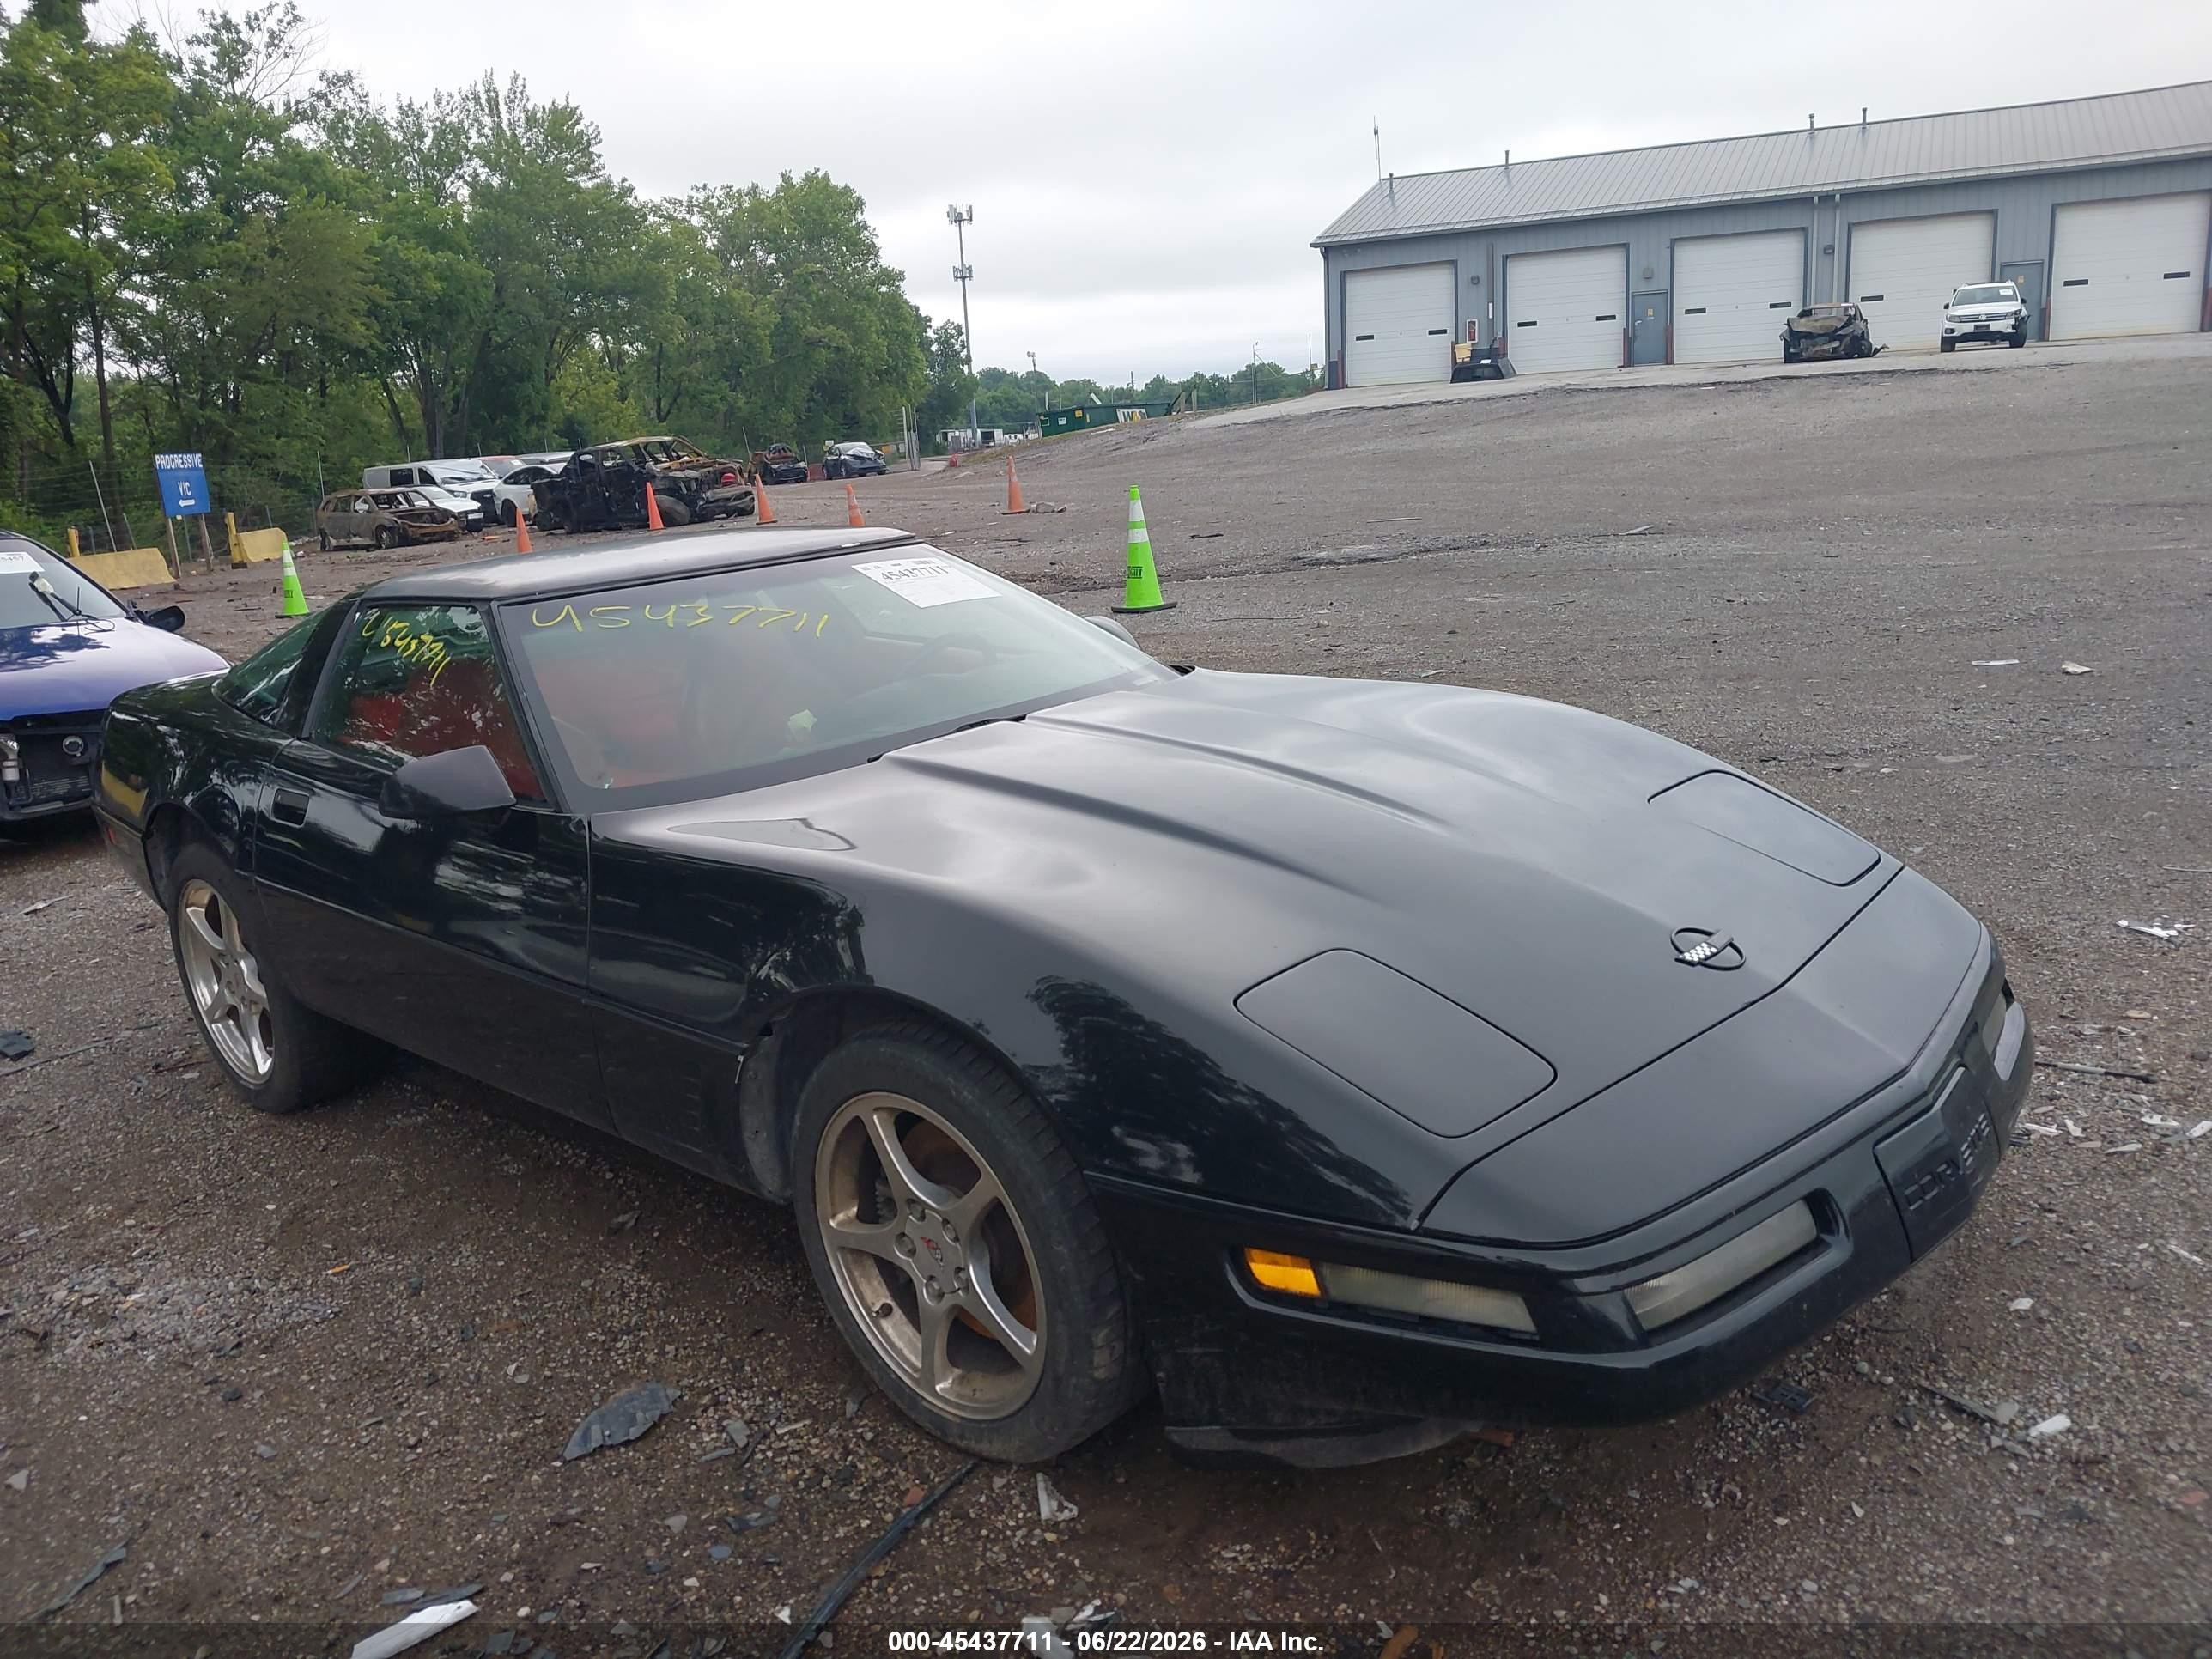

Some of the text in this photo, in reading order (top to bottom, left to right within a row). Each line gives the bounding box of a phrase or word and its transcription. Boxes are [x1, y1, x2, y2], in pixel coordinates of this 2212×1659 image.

[155, 453, 203, 470] PROGRESSIVE
[178, 481, 191, 496] VIC
[881, 565, 949, 581] 45437711
